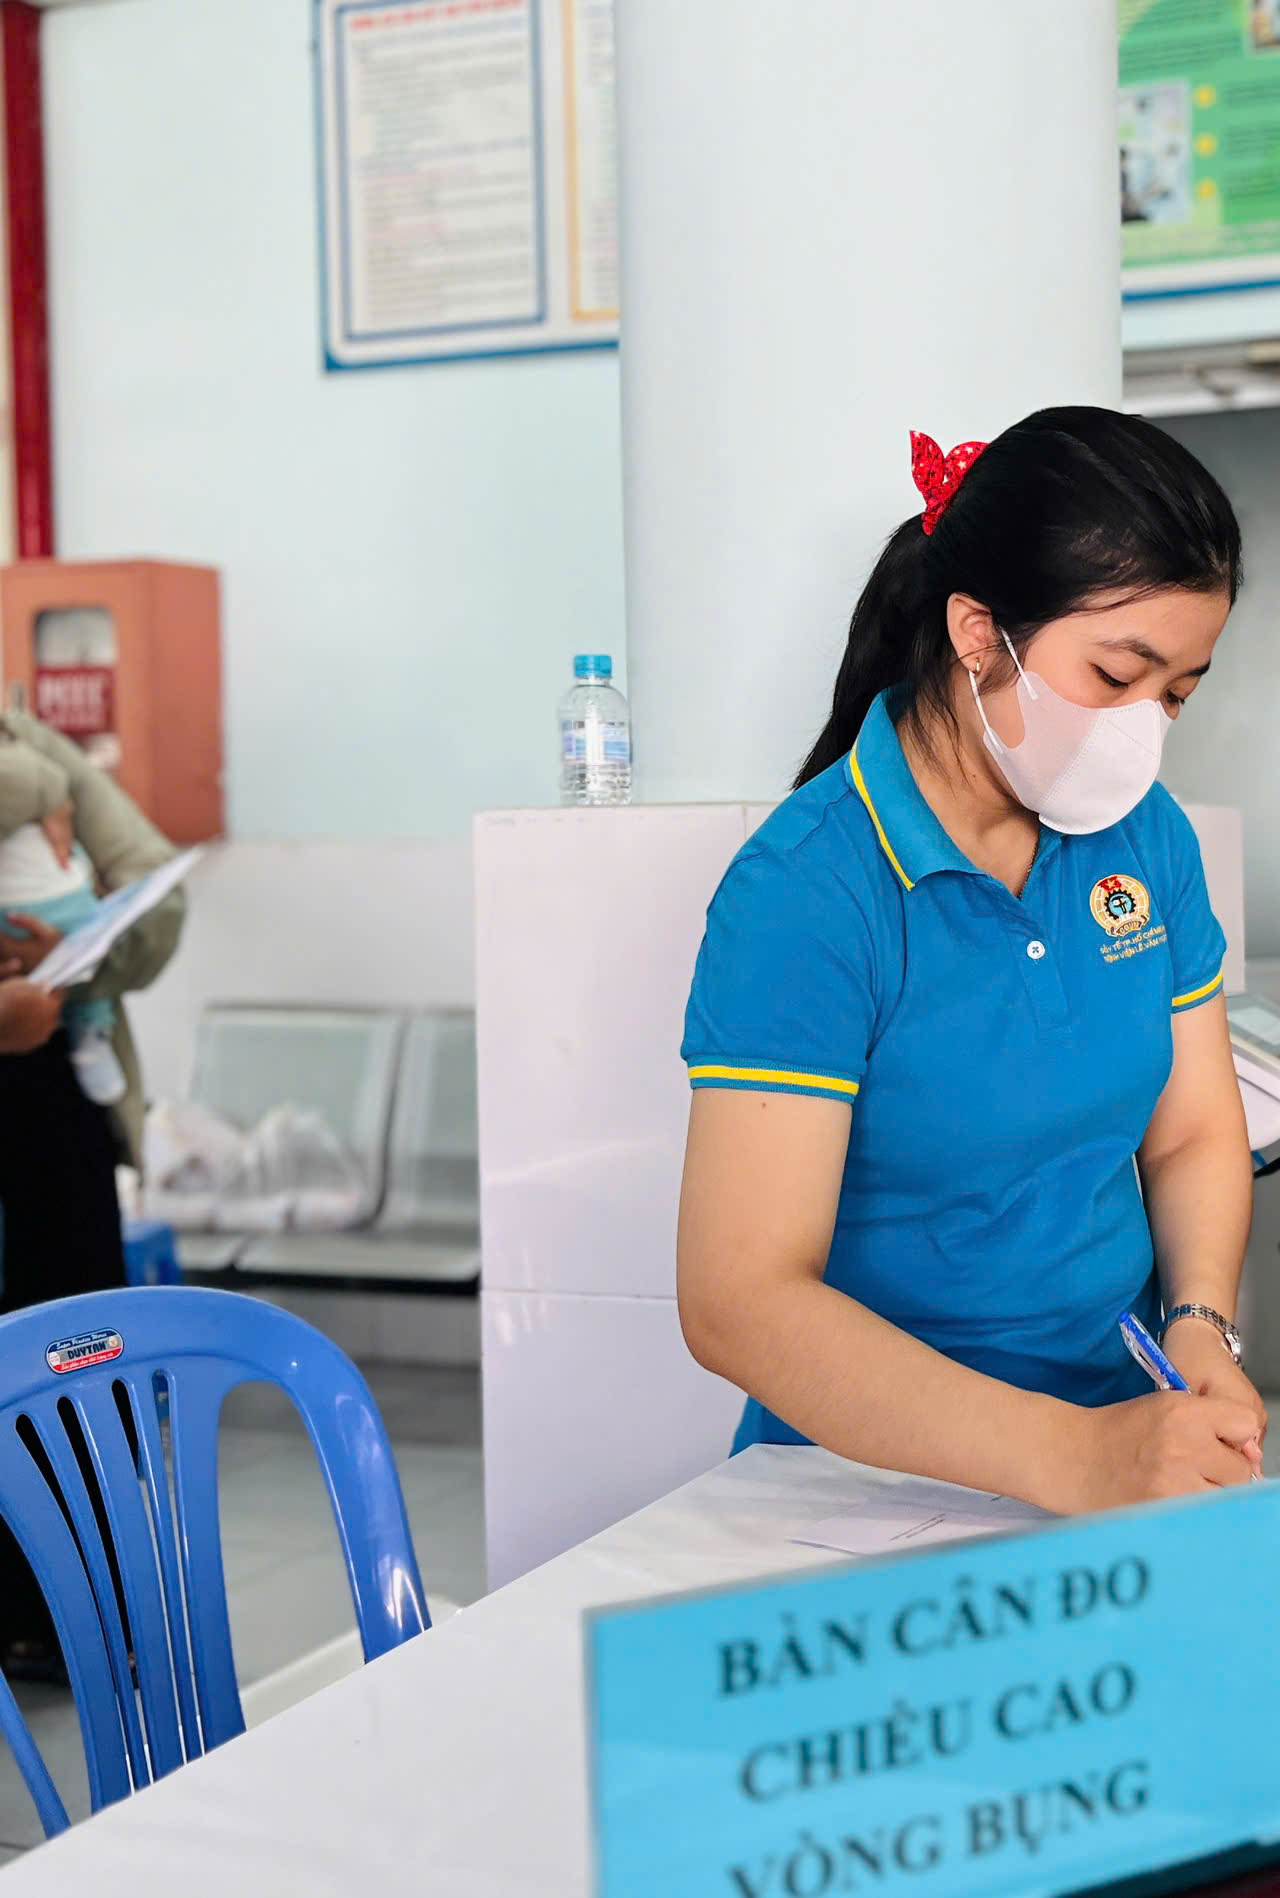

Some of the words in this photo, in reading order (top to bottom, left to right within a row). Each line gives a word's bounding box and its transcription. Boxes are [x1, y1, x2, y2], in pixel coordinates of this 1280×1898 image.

[718, 1609, 869, 1696] BÀN
[890, 1573, 1036, 1659] CÂN
[1055, 1554, 1150, 1623] ĐO
[738, 1696, 973, 1803] CHIỀU
[991, 1661, 1137, 1742] CAO
[728, 1812, 943, 1898] VÒNG
[965, 1760, 1149, 1857] BỤNG
